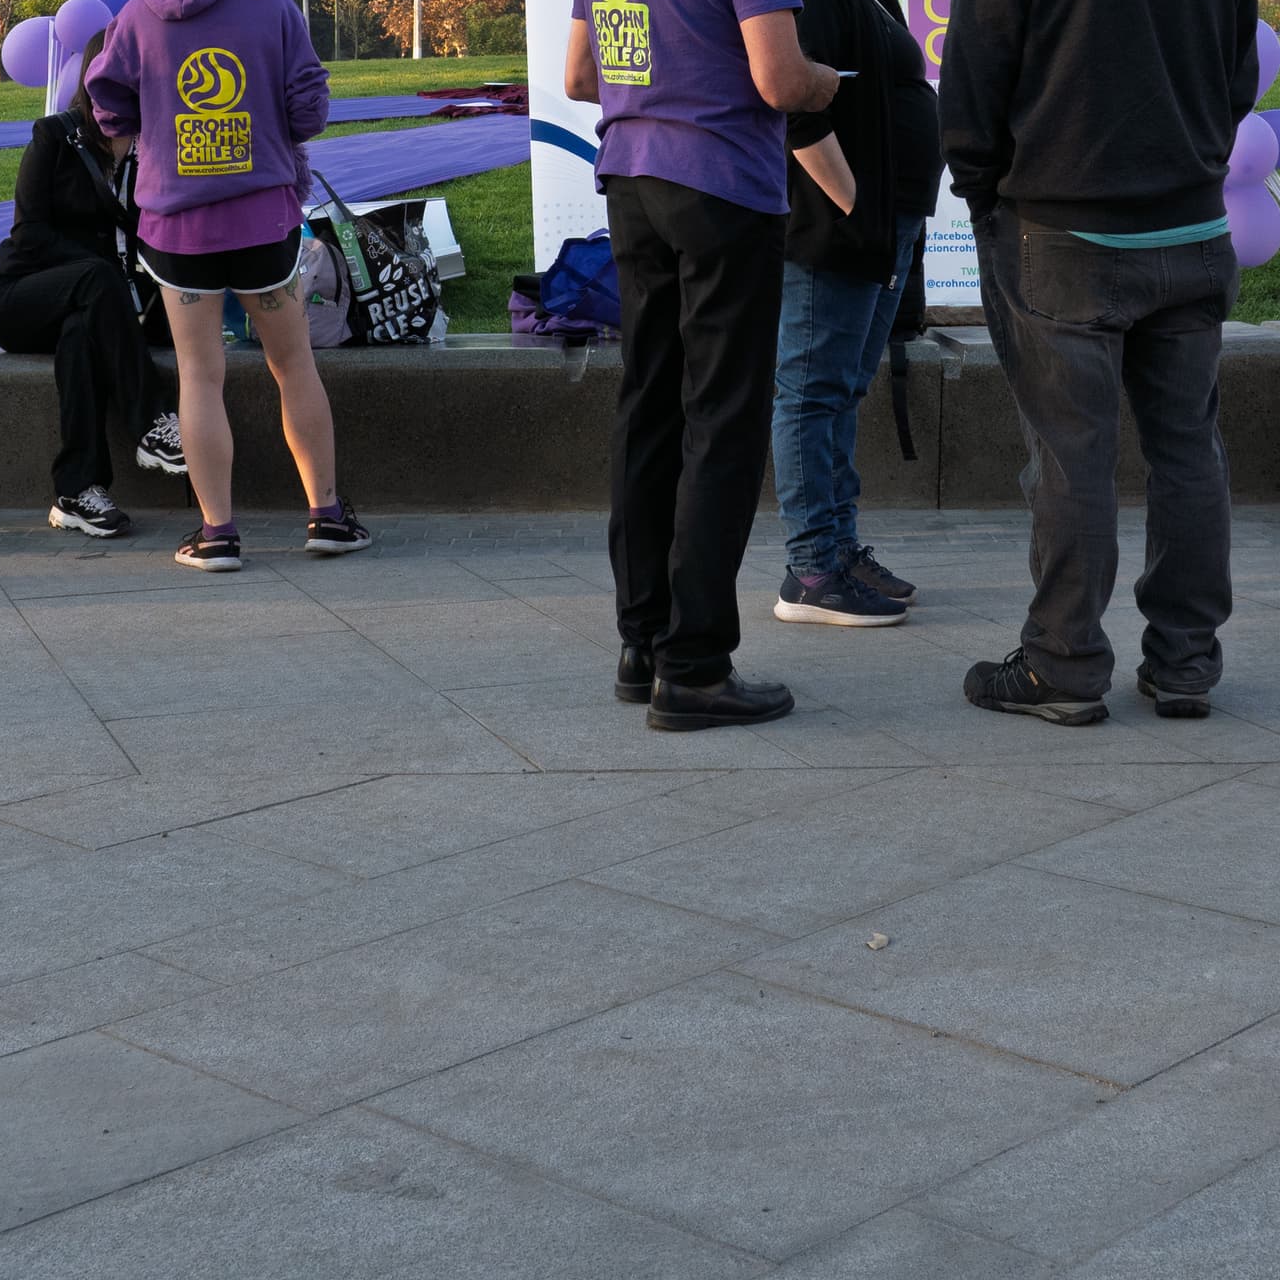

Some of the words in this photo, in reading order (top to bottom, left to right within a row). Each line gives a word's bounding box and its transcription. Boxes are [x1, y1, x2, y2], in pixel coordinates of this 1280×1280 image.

[594, 8, 644, 29] CROHN
[180, 116, 248, 134] CROHN
[180, 131, 249, 148] COLITIS
[180, 145, 233, 163] CHILE
[367, 278, 429, 325] REUSE
